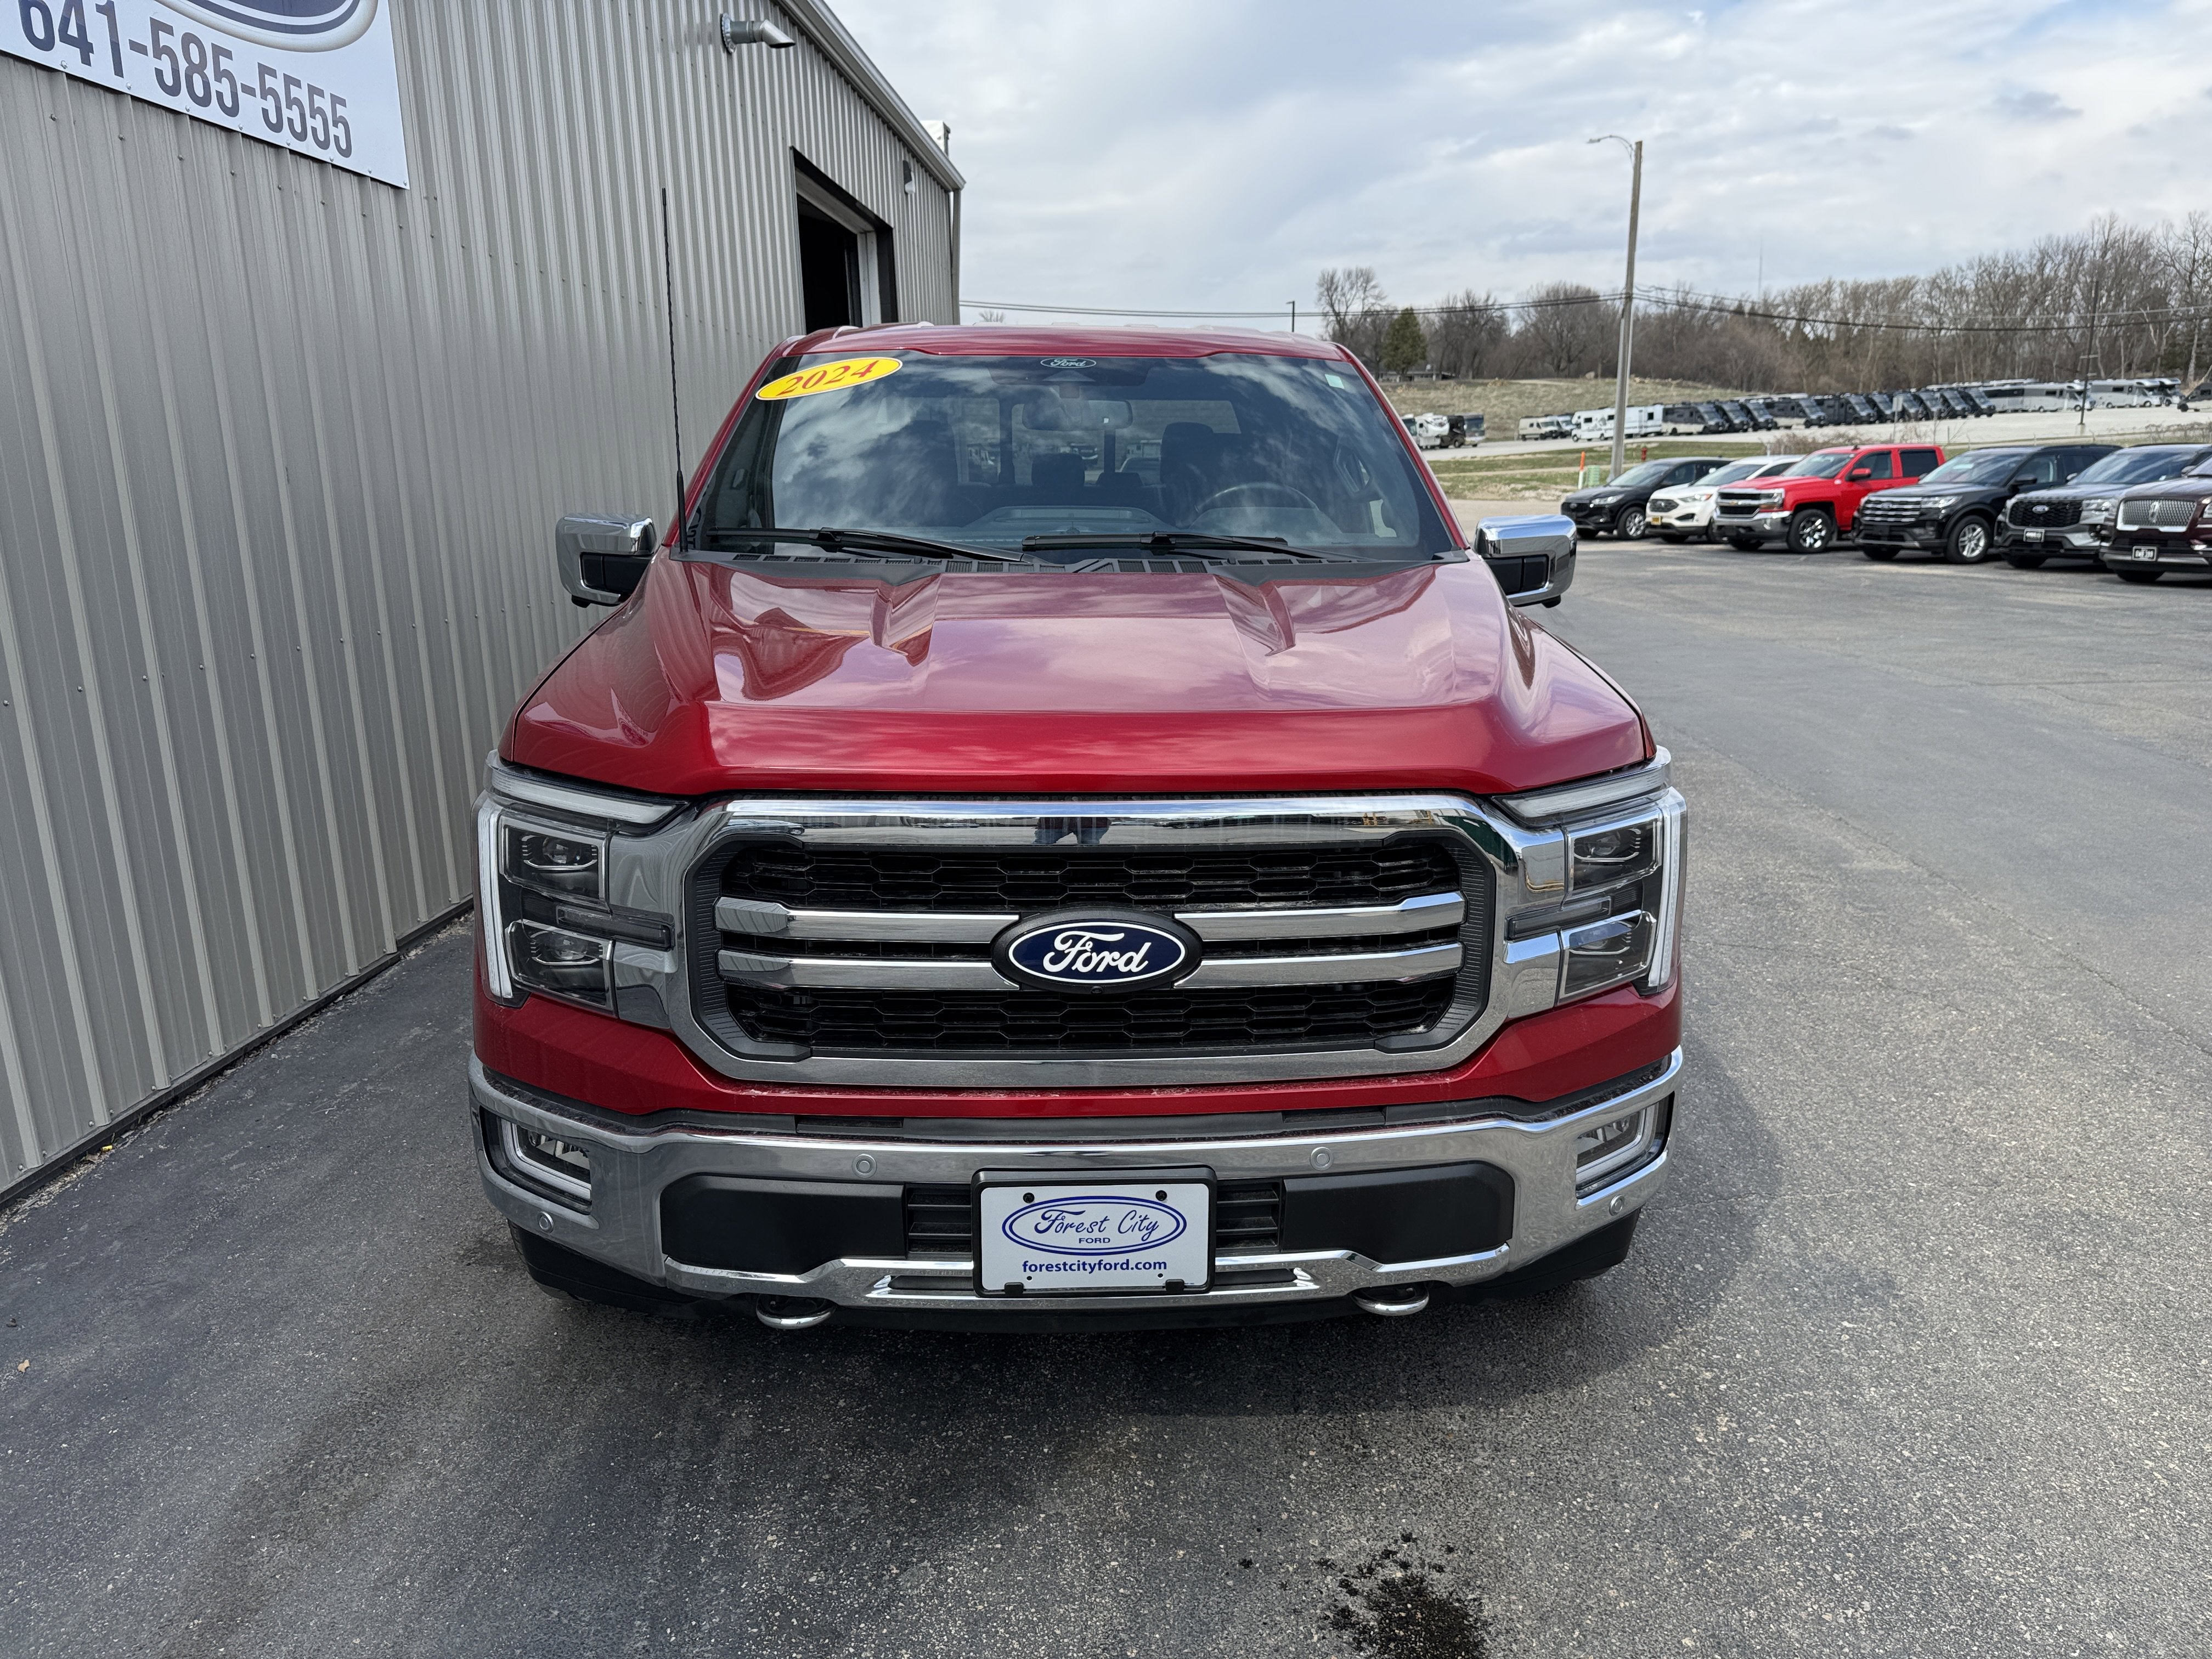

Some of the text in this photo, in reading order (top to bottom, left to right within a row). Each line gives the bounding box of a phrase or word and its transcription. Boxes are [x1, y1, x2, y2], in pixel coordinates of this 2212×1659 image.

[18, 0, 353, 159] 641-585-5555
[775, 360, 879, 397] 2024
[1050, 358, 1087, 366] Ford
[1042, 930, 1152, 973] Ford
[1034, 1209, 1160, 1242] Forest City
[1022, 1259, 1167, 1274] forestcityford.com
